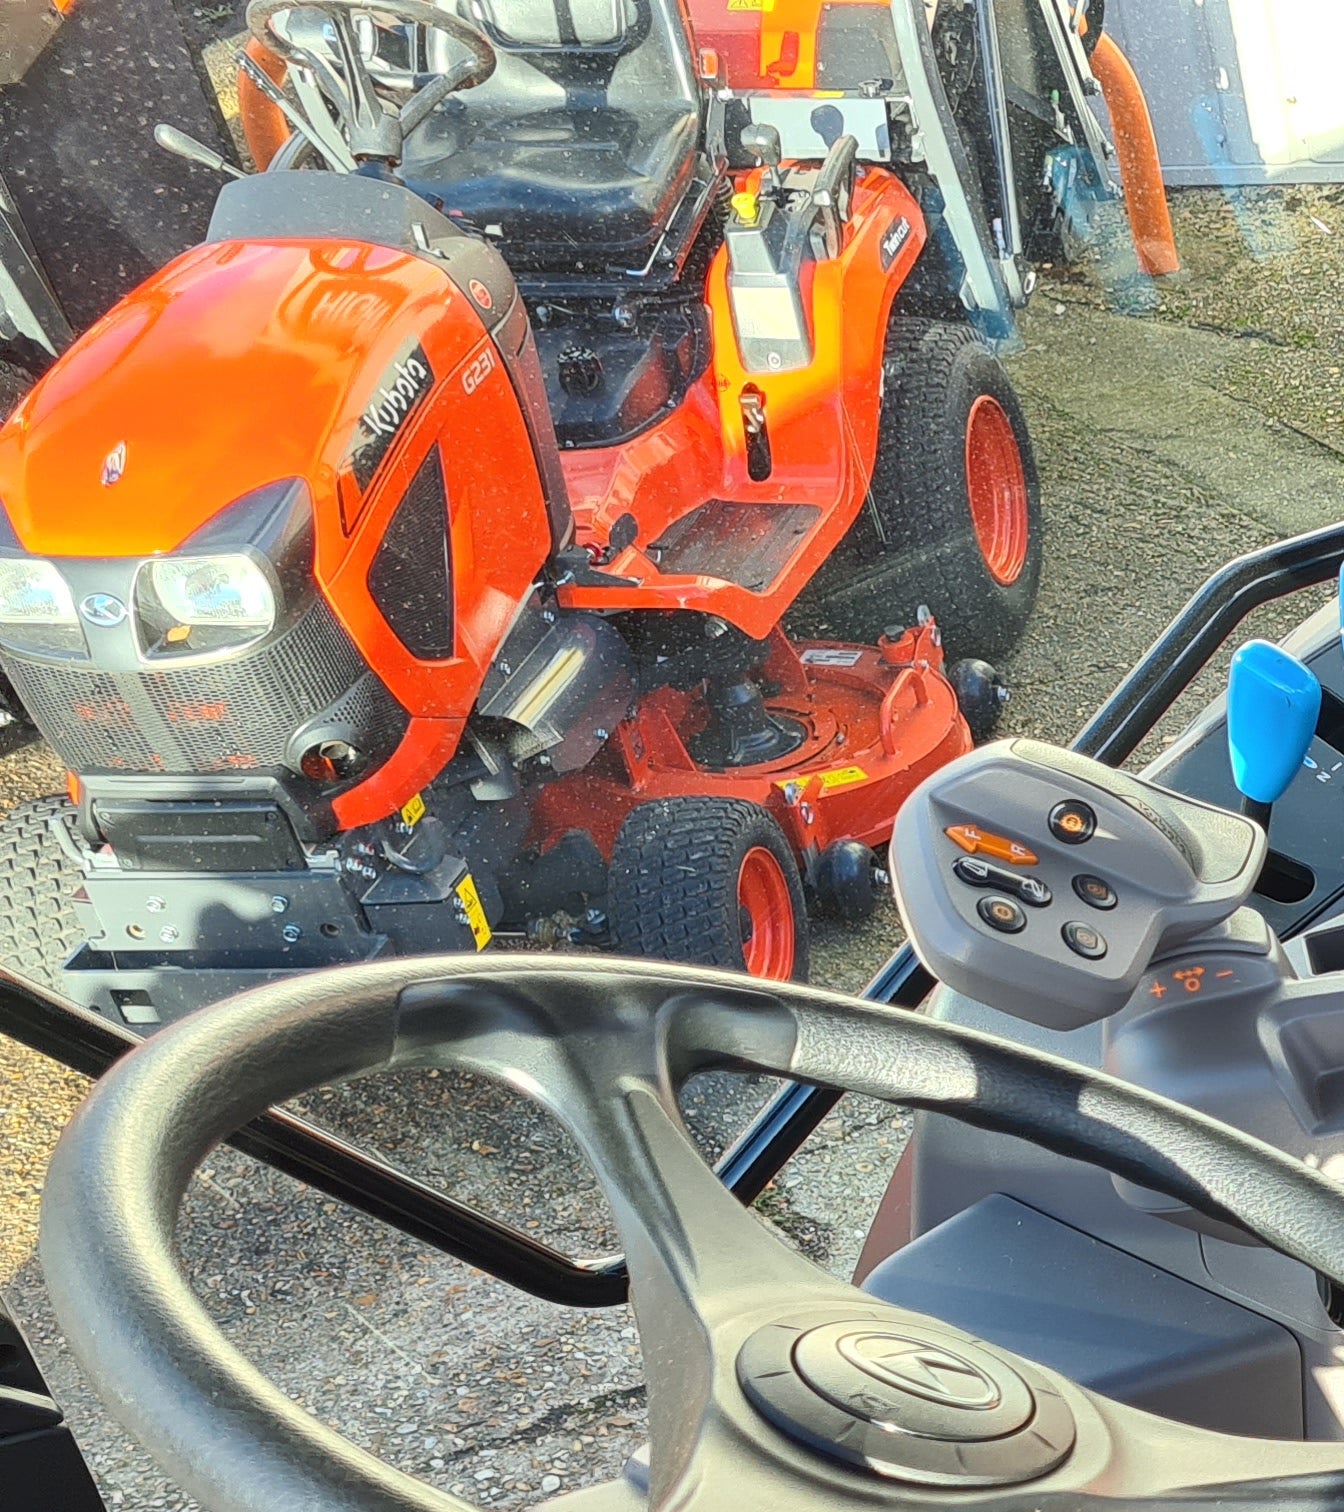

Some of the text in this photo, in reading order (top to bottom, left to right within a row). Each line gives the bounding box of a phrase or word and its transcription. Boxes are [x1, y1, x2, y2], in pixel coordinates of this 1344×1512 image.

[461, 348, 496, 395] G231
[363, 357, 427, 436] Kubota
[964, 826, 982, 840] F
[1010, 843, 1026, 856] R
